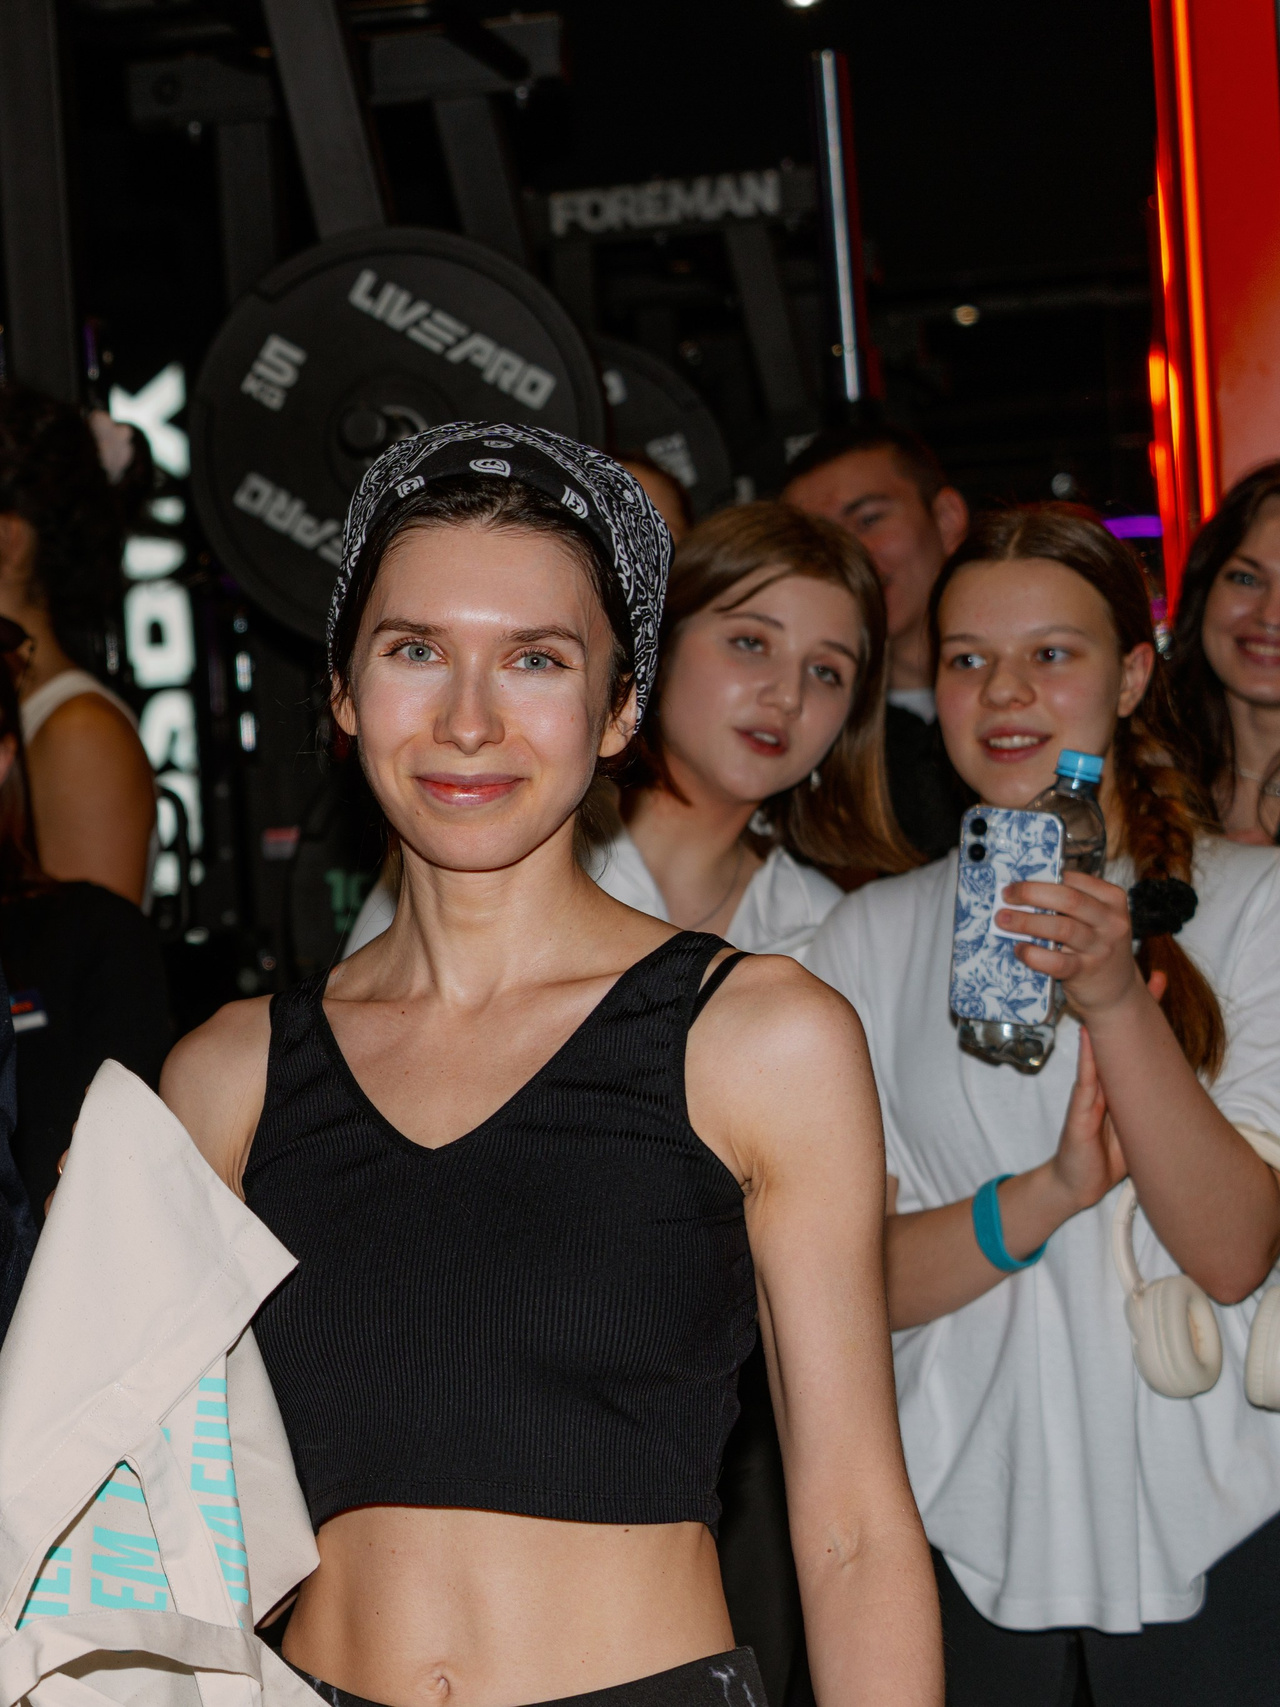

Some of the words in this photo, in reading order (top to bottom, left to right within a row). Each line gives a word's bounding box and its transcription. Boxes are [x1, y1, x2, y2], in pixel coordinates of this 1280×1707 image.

[549, 167, 780, 237] FOREMAN
[251, 333, 308, 390] 5
[348, 268, 557, 412] LIVEPRO
